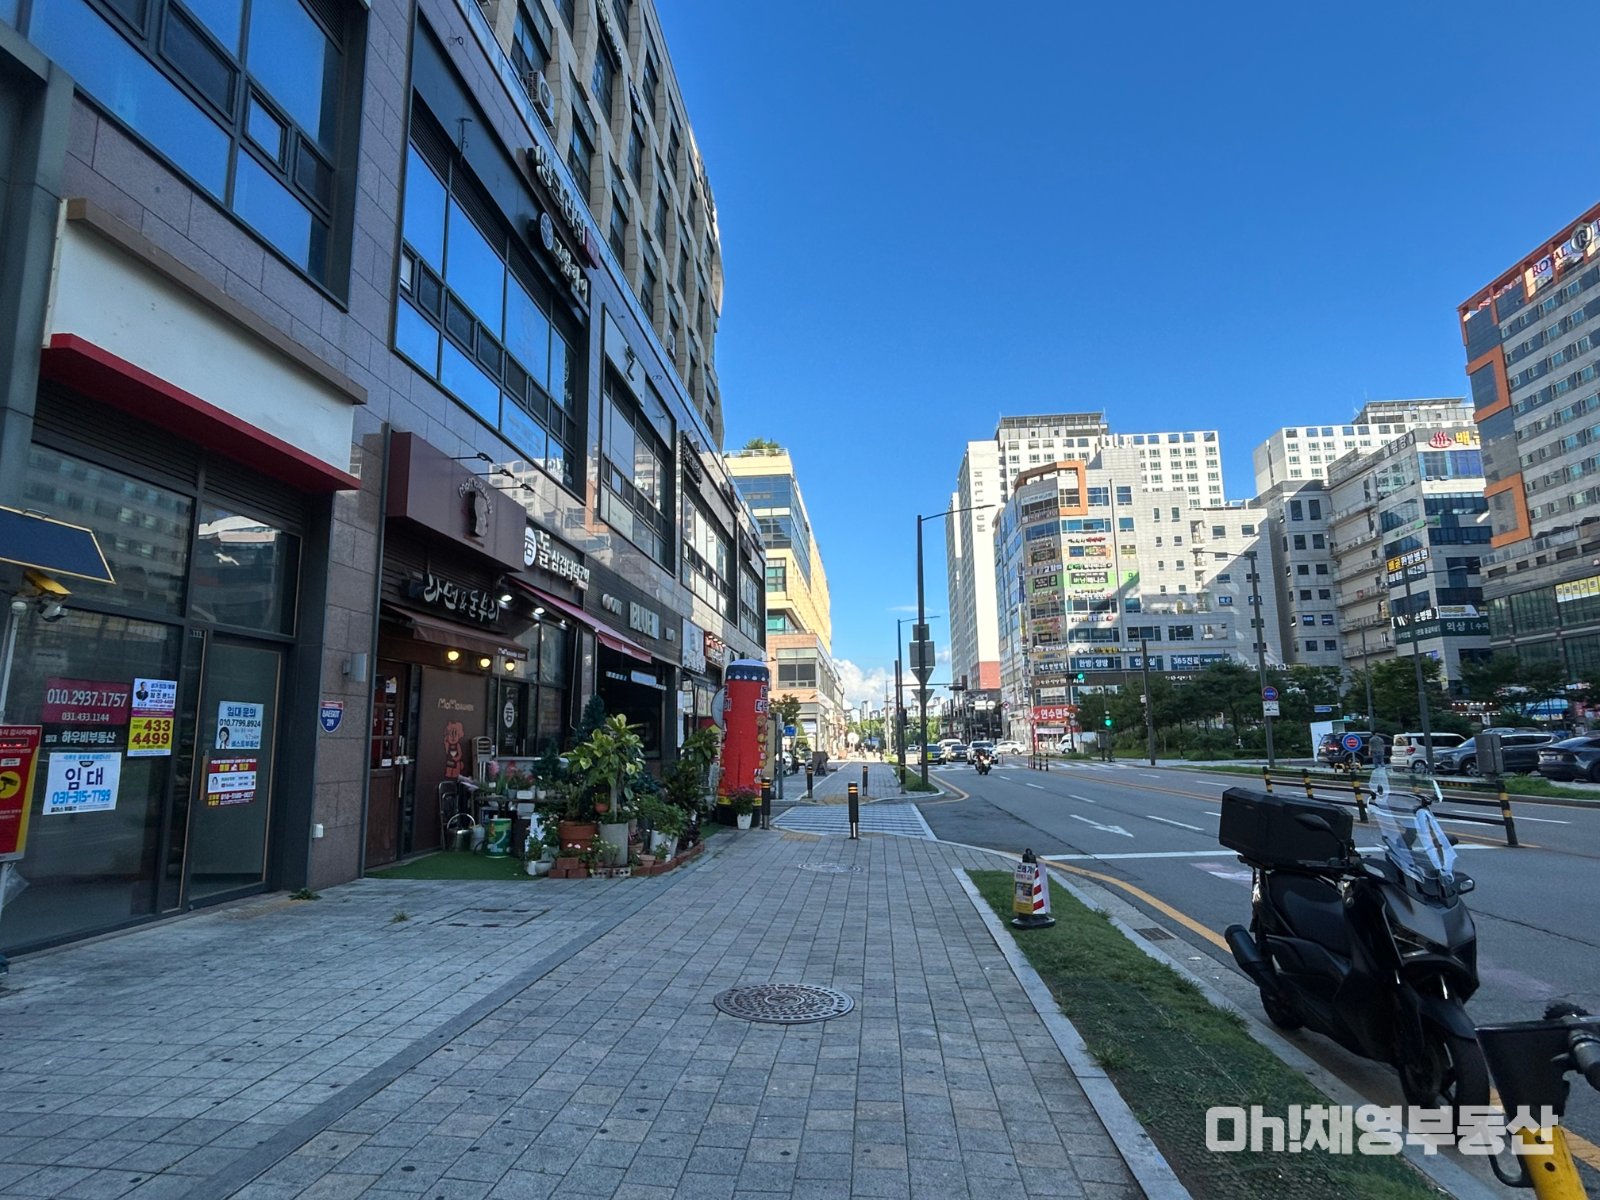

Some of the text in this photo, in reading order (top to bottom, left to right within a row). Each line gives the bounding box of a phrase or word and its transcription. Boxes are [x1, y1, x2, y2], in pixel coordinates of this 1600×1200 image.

[1134, 658, 1156, 666] 입실
[47, 688, 128, 708] 010.2937.1757
[61, 711, 110, 722] 031.433.1144
[144, 719, 171, 732] 433
[131, 732, 170, 745] 4499
[52, 789, 111, 805] 031-315-7799
